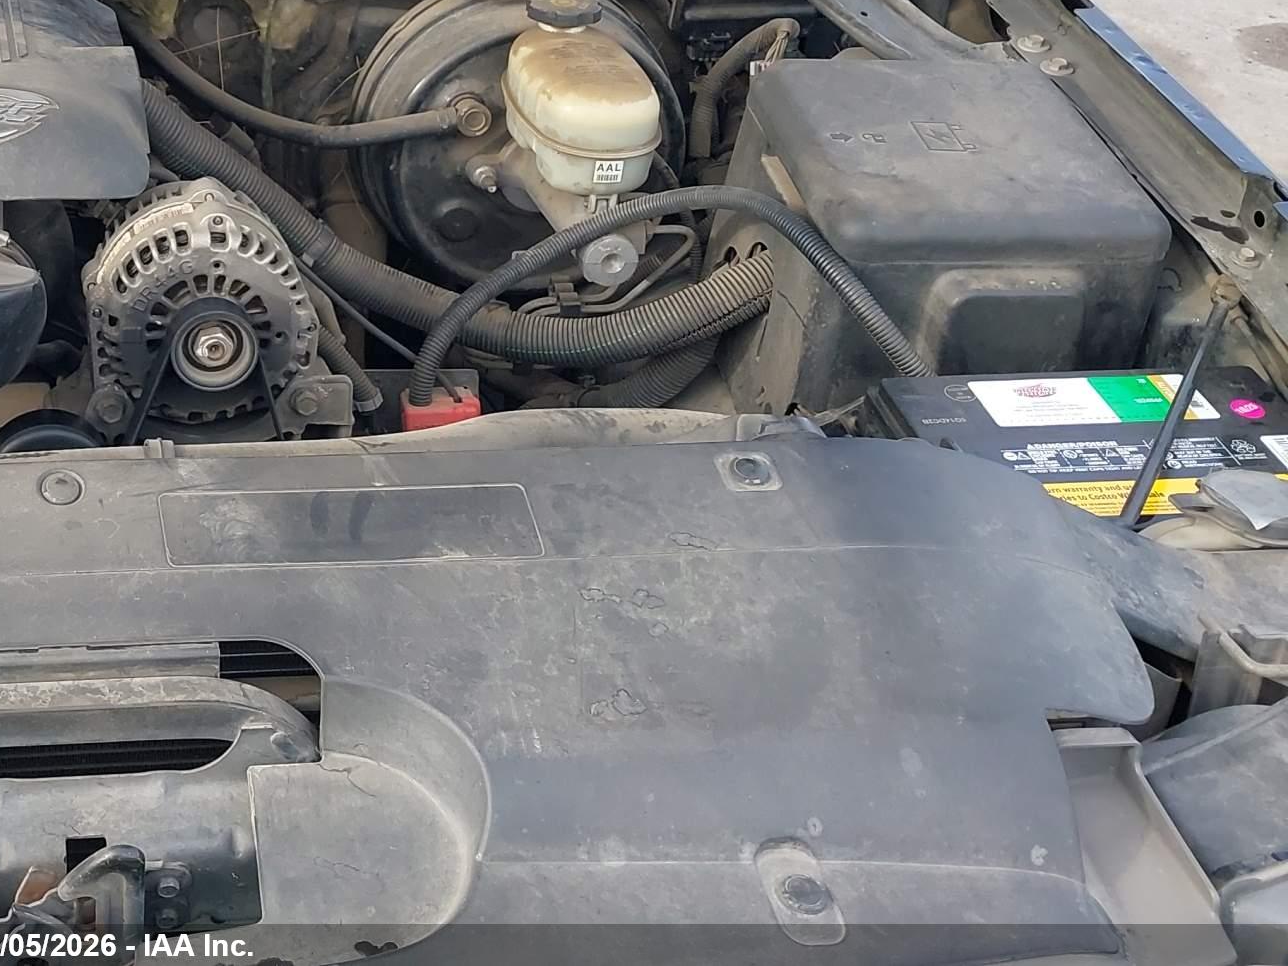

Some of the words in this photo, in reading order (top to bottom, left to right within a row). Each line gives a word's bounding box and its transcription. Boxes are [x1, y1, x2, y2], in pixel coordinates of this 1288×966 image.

[596, 163, 621, 172] AAL
[1064, 485, 1102, 495] warranty
[1088, 492, 1118, 501] Costco
